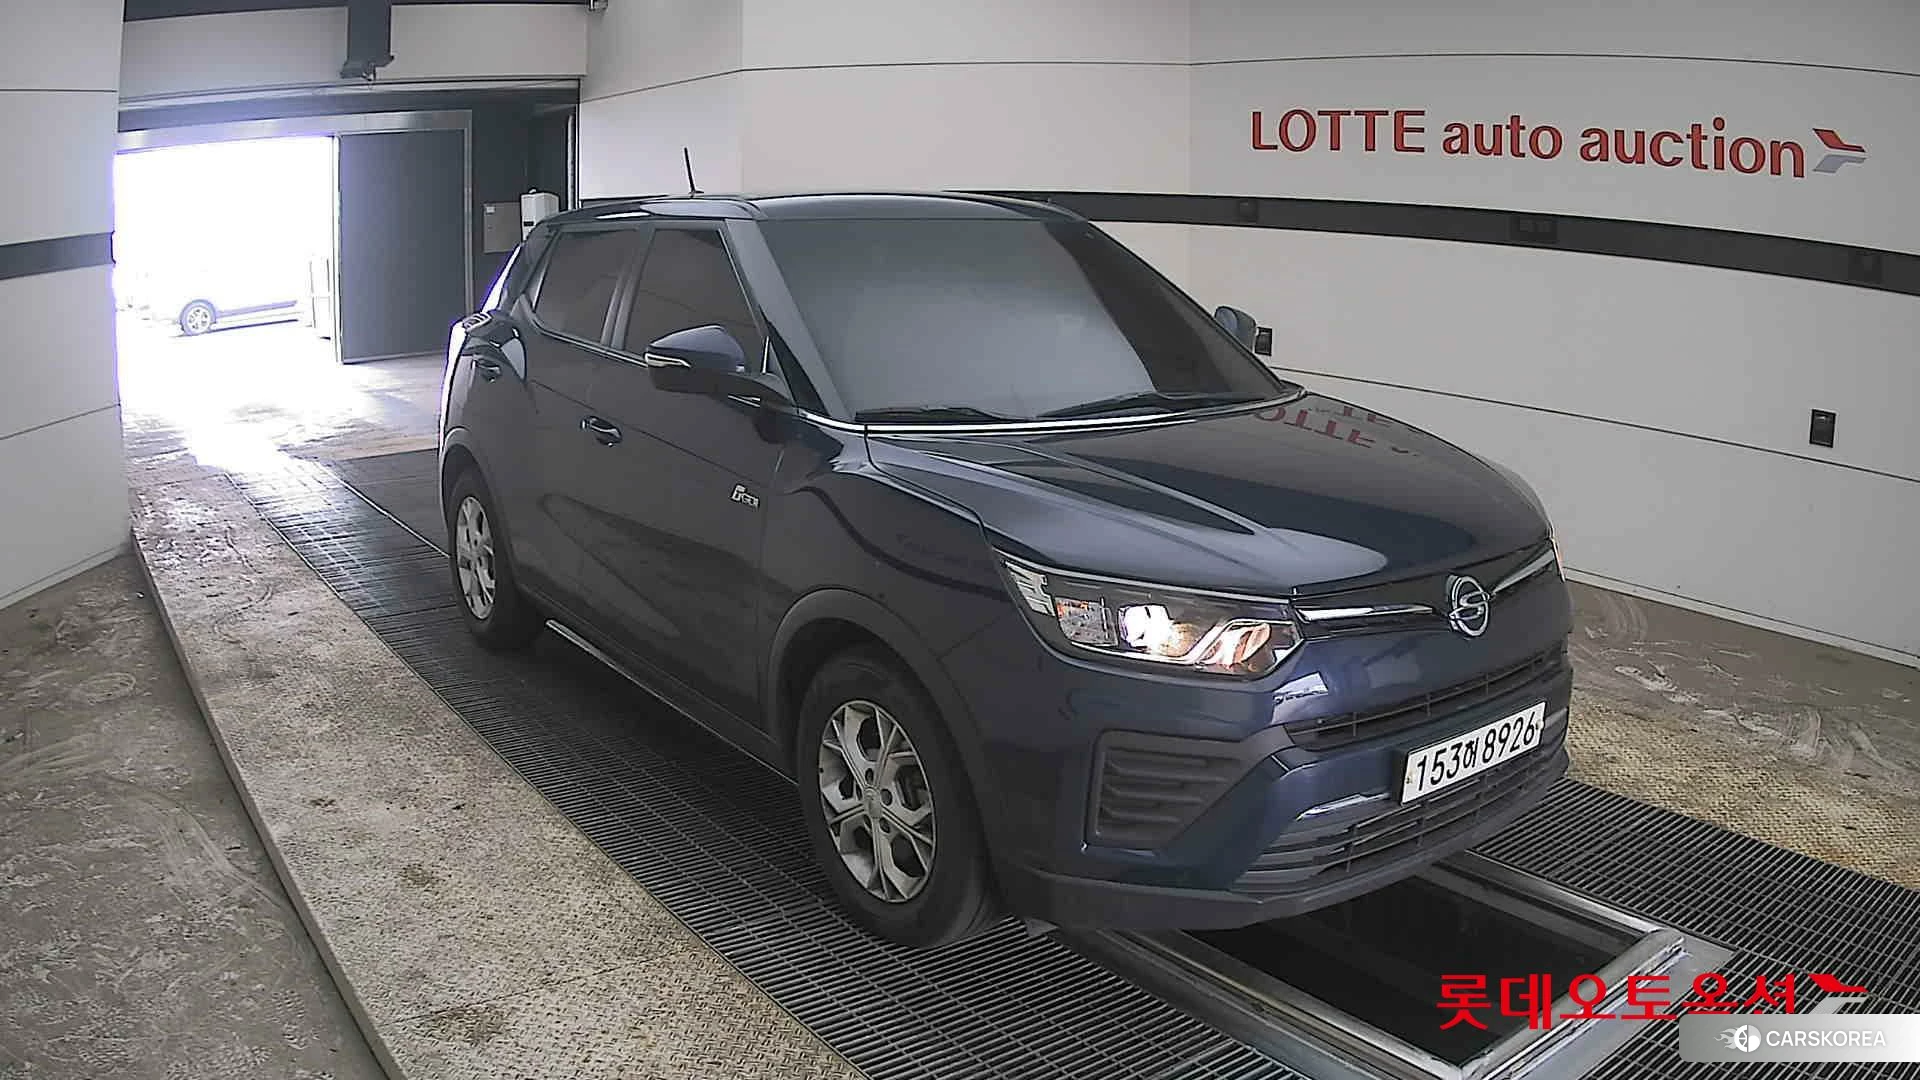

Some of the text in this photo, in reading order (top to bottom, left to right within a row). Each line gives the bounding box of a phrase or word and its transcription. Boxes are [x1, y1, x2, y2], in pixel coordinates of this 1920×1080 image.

[1250, 109, 1806, 179] LOTTE auto auction
